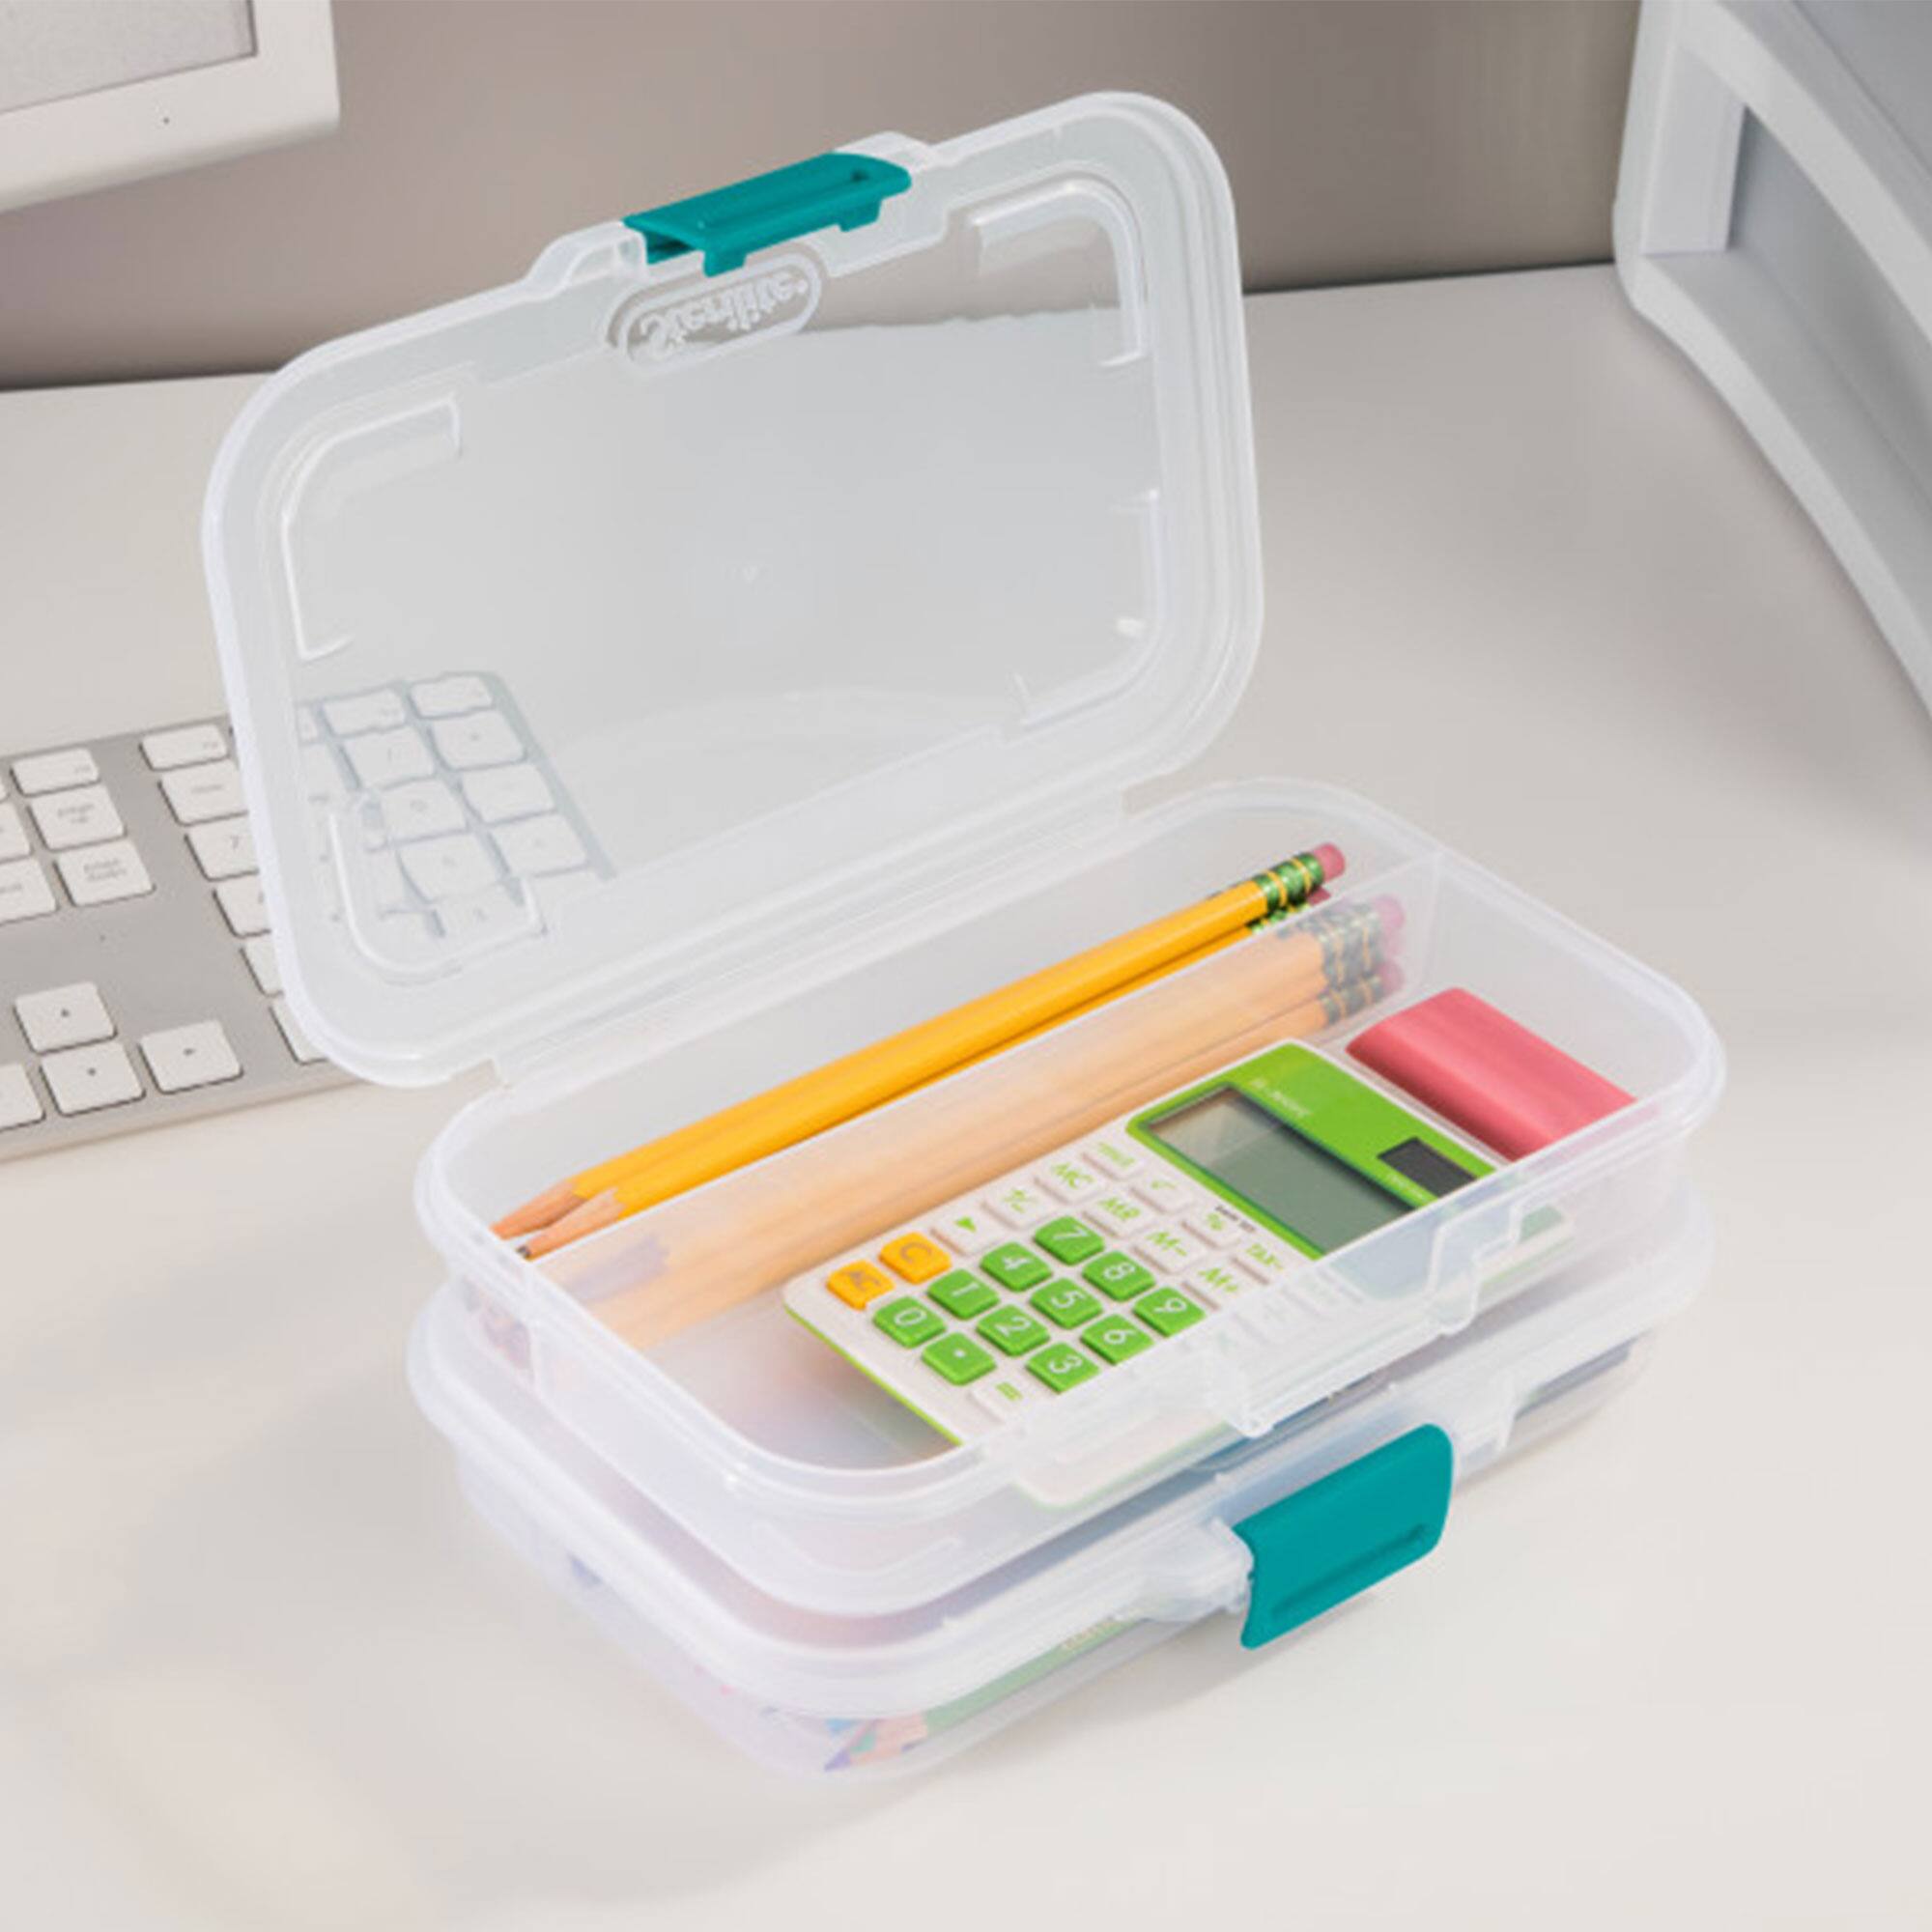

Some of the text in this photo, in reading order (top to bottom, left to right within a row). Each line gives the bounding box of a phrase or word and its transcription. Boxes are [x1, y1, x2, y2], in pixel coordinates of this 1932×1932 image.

[1052, 1223, 1089, 1241] 7
[899, 1241, 932, 1264] C
[1002, 1256, 1032, 1270] 4
[1102, 1262, 1136, 1281] 8
[951, 1282, 980, 1297] 1
[1050, 1290, 1085, 1309] 5
[1154, 1297, 1188, 1314] 9
[893, 1307, 927, 1327] 0
[995, 1316, 1032, 1338] 2
[1102, 1328, 1138, 1346] 6
[1048, 1354, 1083, 1375] 3
